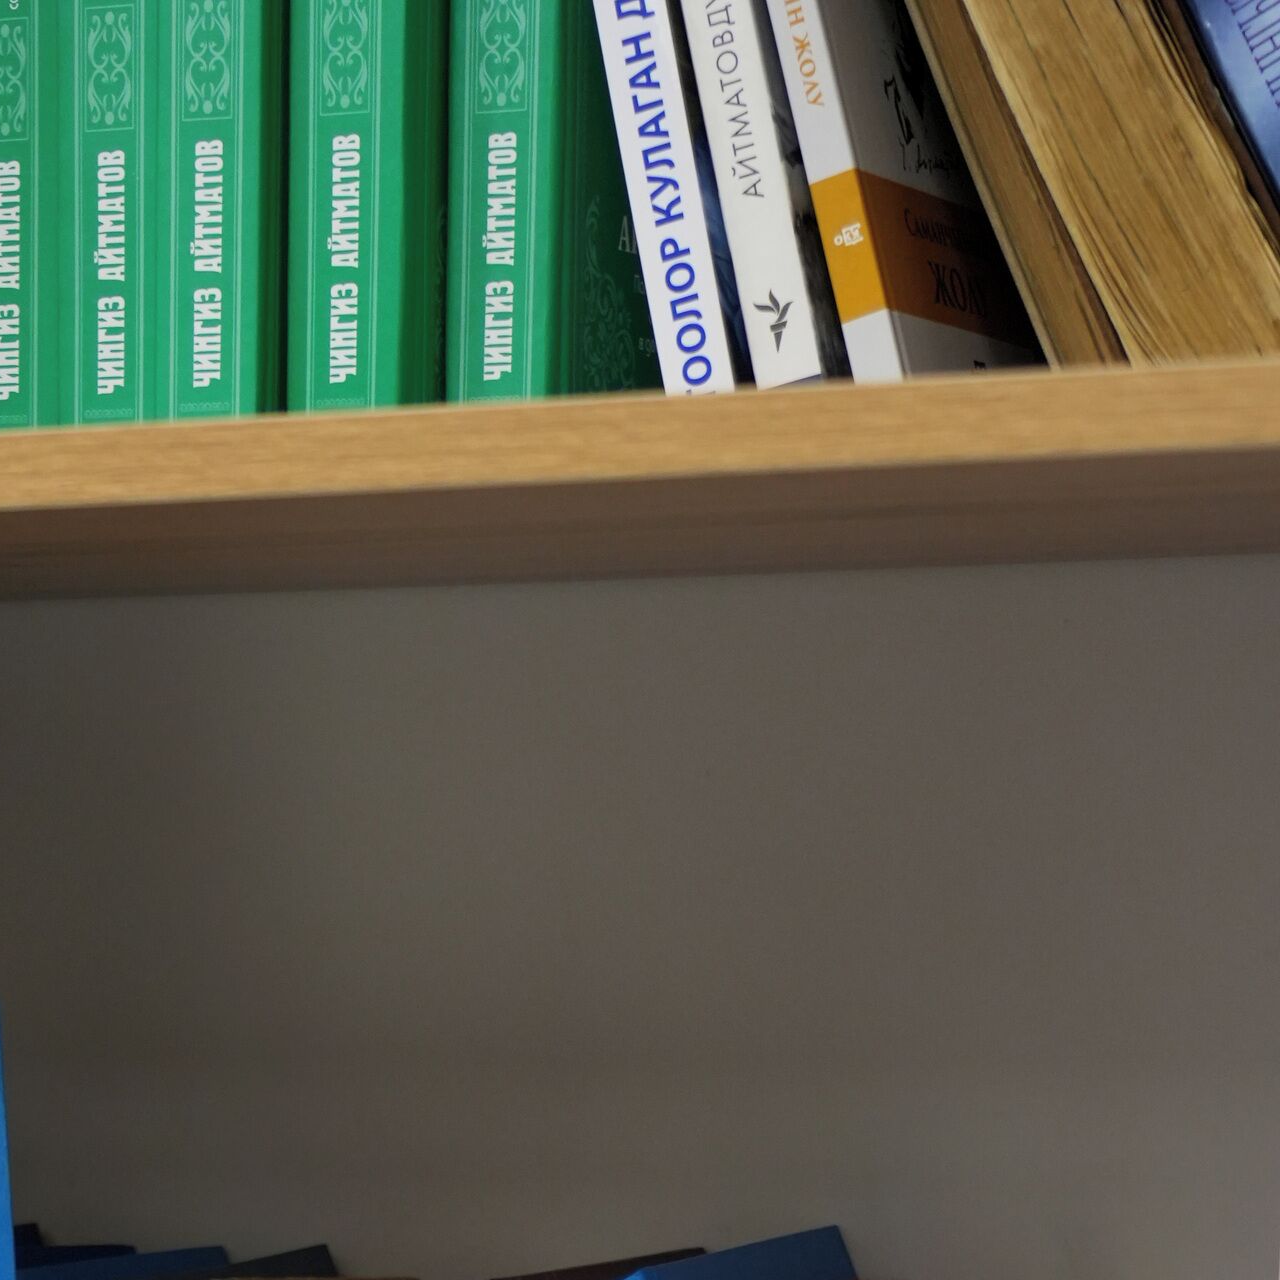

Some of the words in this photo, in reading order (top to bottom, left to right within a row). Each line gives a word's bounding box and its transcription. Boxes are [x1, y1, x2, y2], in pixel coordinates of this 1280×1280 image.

[624, 28, 685, 228] КУЛАГАН
[792, 32, 824, 107] ЖОЛУ
[94, 150, 125, 281] АЙТМАТОВ
[190, 140, 223, 273] АЙТМАТОВ
[327, 133, 360, 268] АЙТМАТОВ
[482, 131, 517, 266] АЙТМАТОВ
[97, 296, 125, 395] ЧИНГИЗ
[193, 287, 222, 388] ЧИНГИЗ
[329, 282, 358, 384] ЧИНГИЗ
[483, 279, 514, 381] ЧИНГИЗ
[661, 238, 715, 396] ООЛОР
